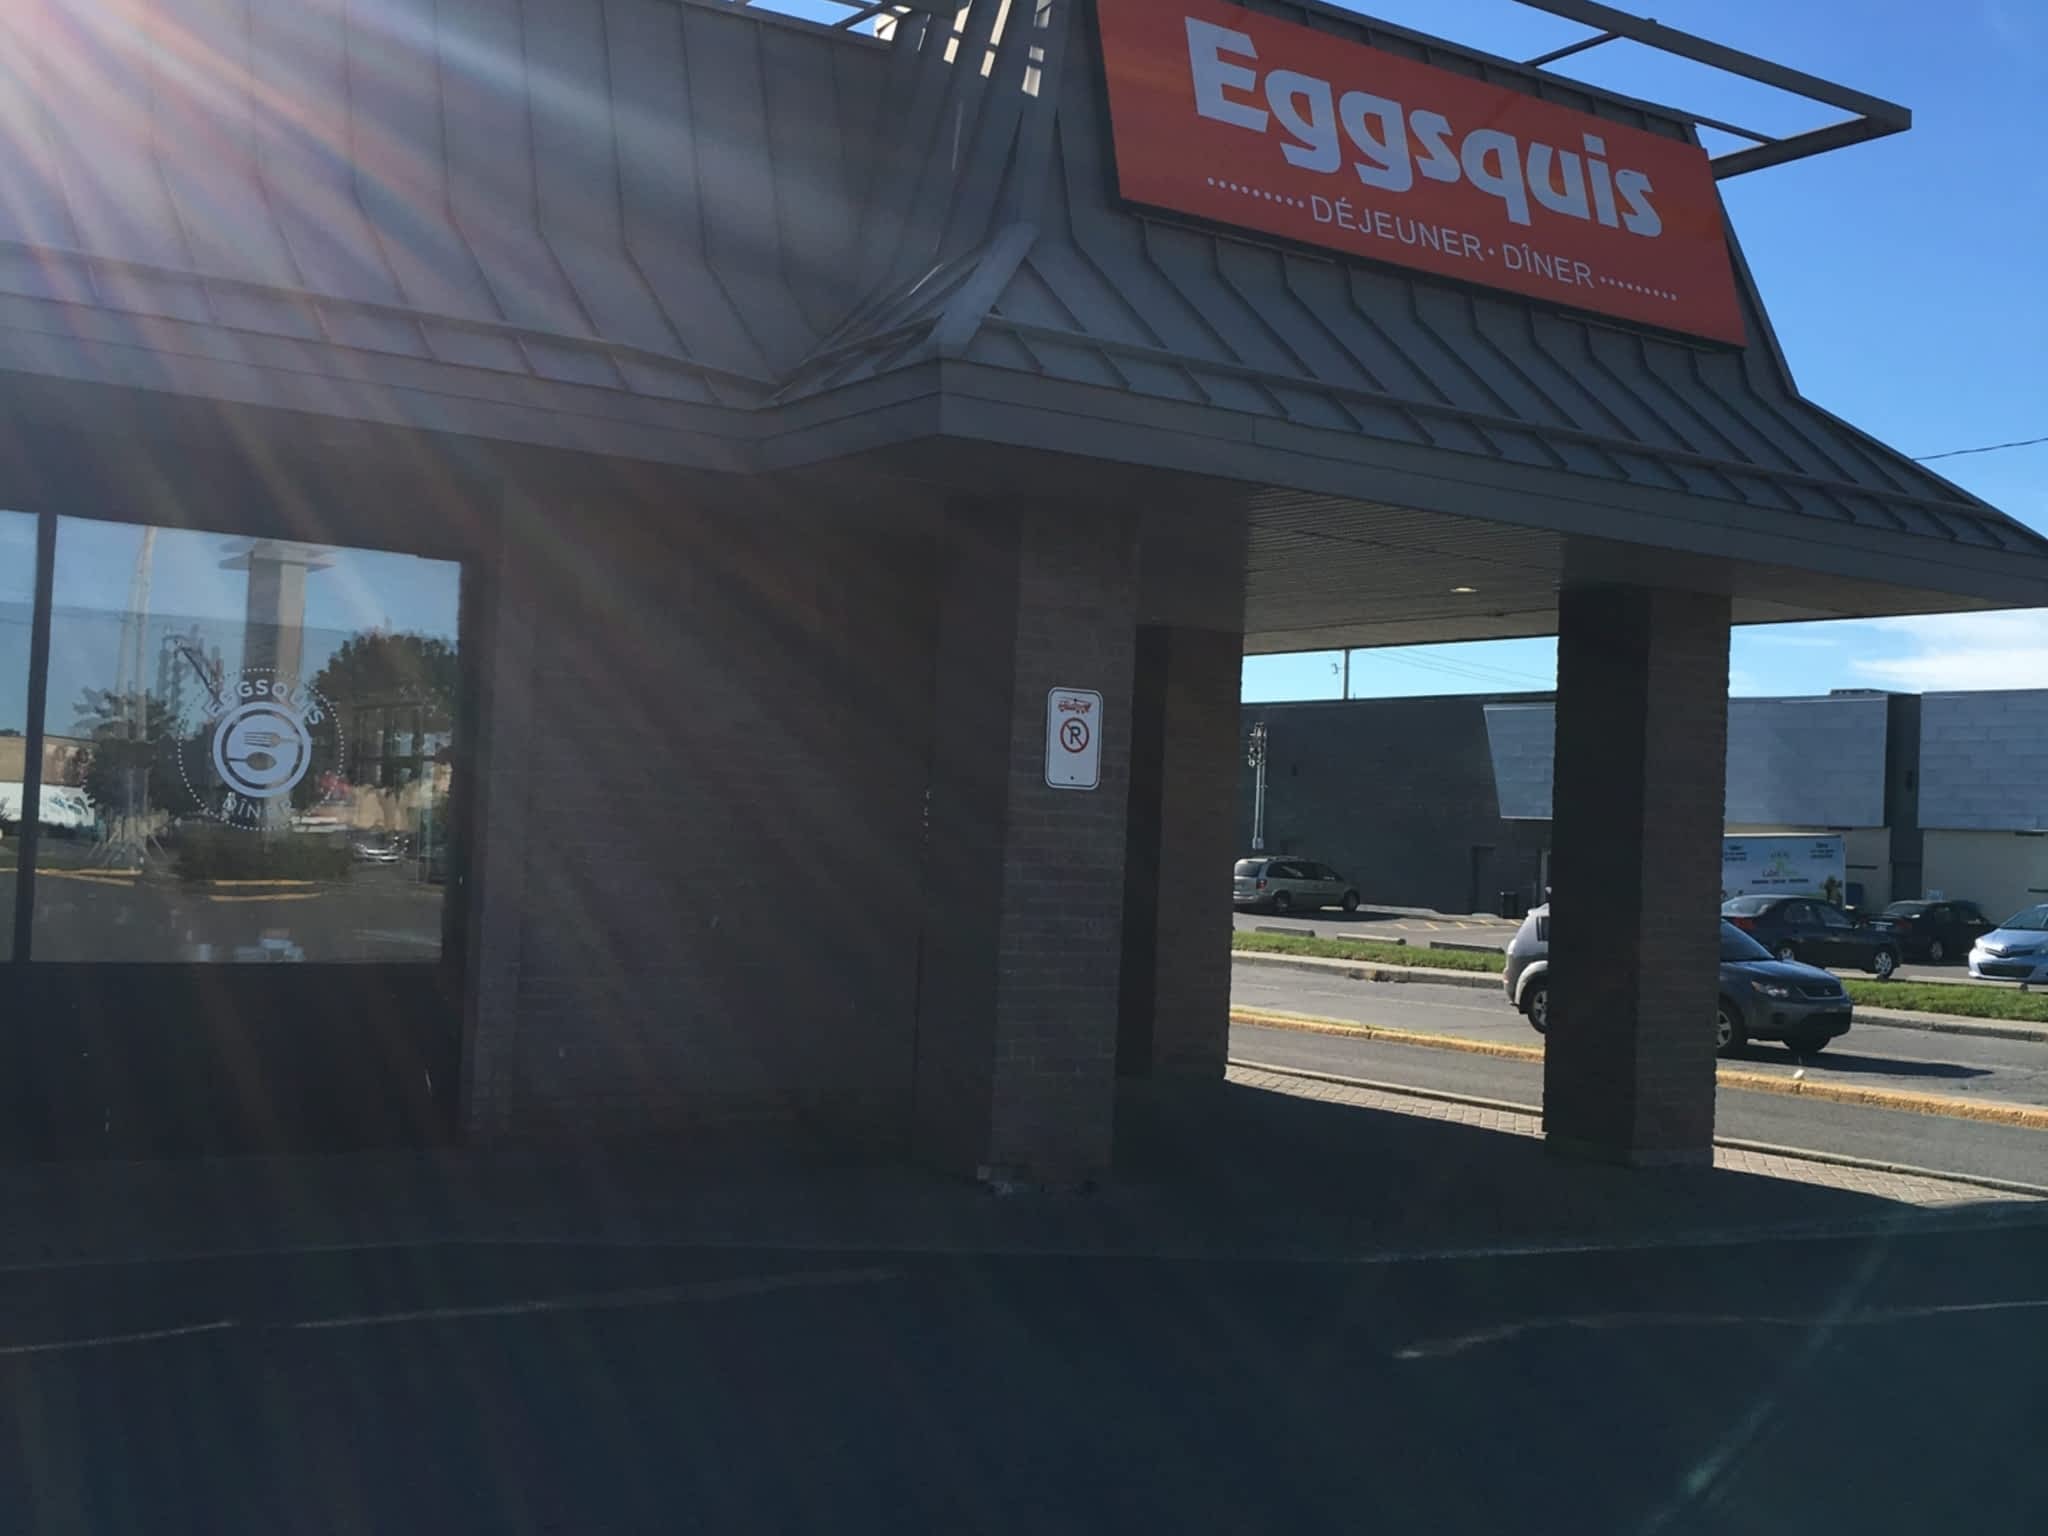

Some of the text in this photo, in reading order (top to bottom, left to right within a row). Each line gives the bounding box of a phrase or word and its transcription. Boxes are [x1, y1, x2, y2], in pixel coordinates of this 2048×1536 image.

[1185, 16, 1662, 238] Eggsquis
[1310, 194, 1595, 289] DÉJEUNER DÎNER
